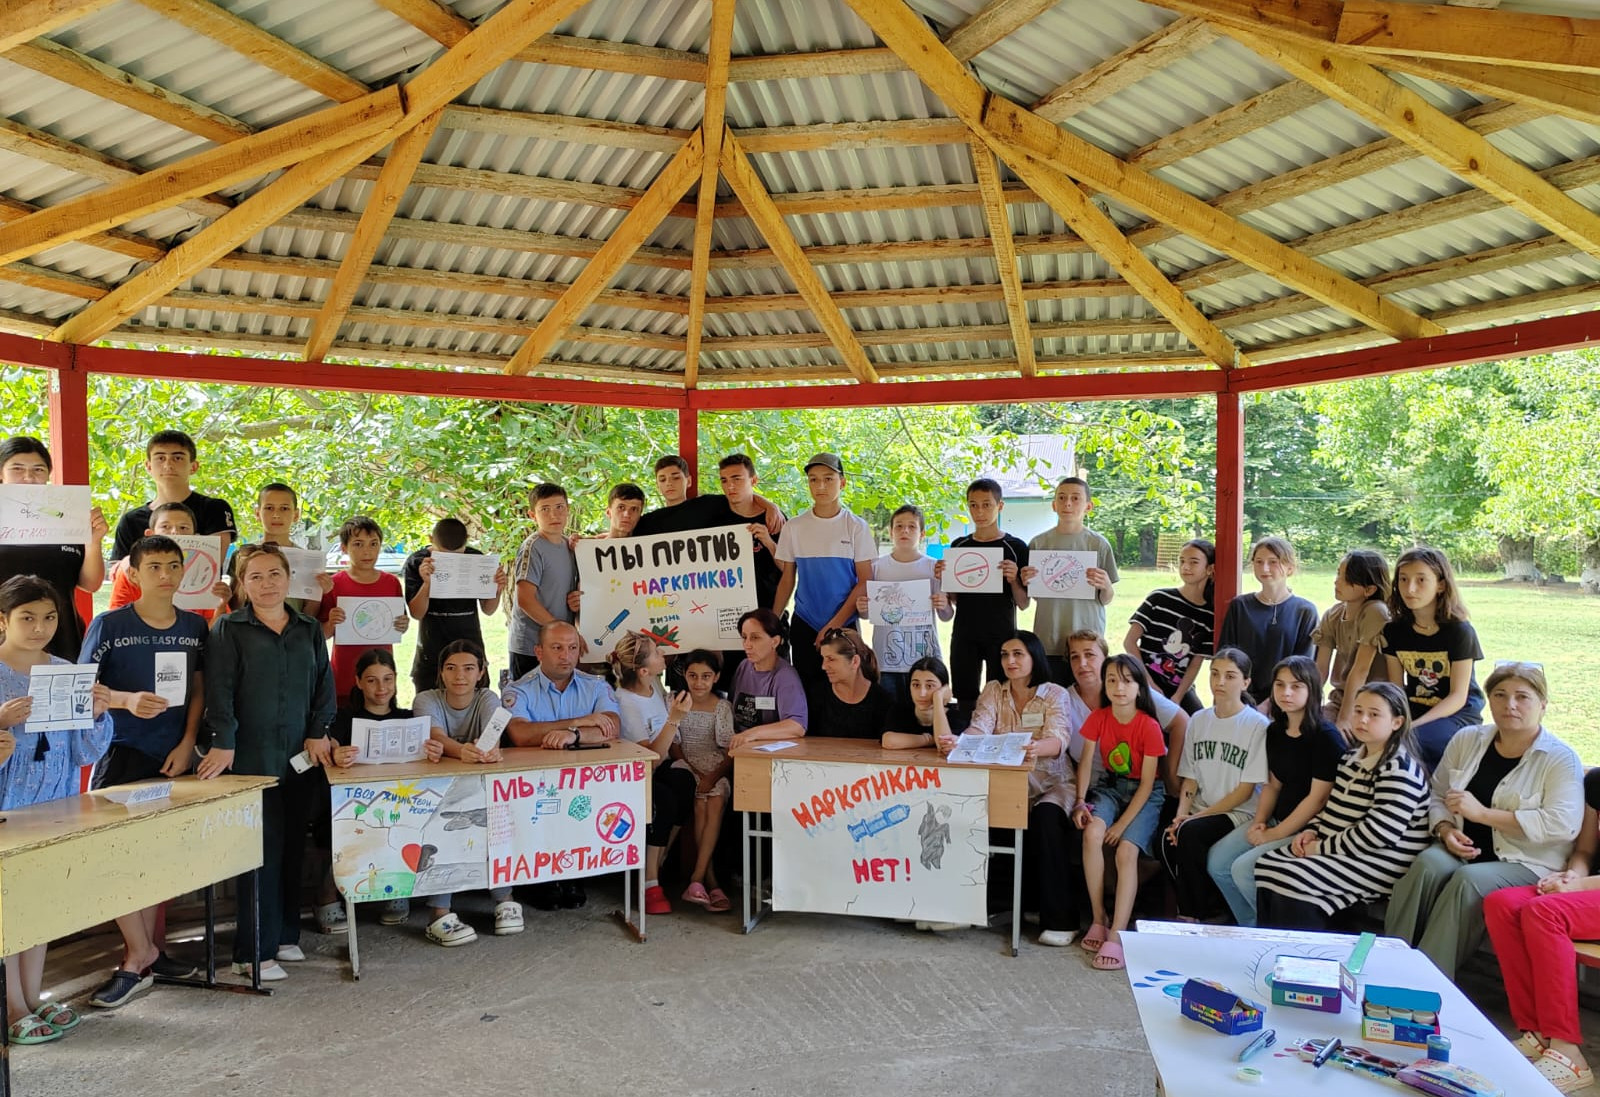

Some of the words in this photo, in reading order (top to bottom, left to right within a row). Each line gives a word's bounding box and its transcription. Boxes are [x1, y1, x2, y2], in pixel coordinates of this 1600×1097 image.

[595, 543, 643, 572] МЫ
[651, 531, 740, 567] ПРОТИВ
[632, 566, 744, 596] НАРКОТИКОВ!
[92, 640, 111, 662] EASY
[114, 636, 150, 647] GOING
[152, 635, 177, 645] EASY
[558, 761, 645, 790] ПРОТИВ
[344, 787, 375, 799] ТВОЯ
[791, 765, 942, 829] НАРКОТИКАМ
[493, 843, 640, 884] НАРКОТИКОВ
[852, 857, 911, 885] НЕТ!
